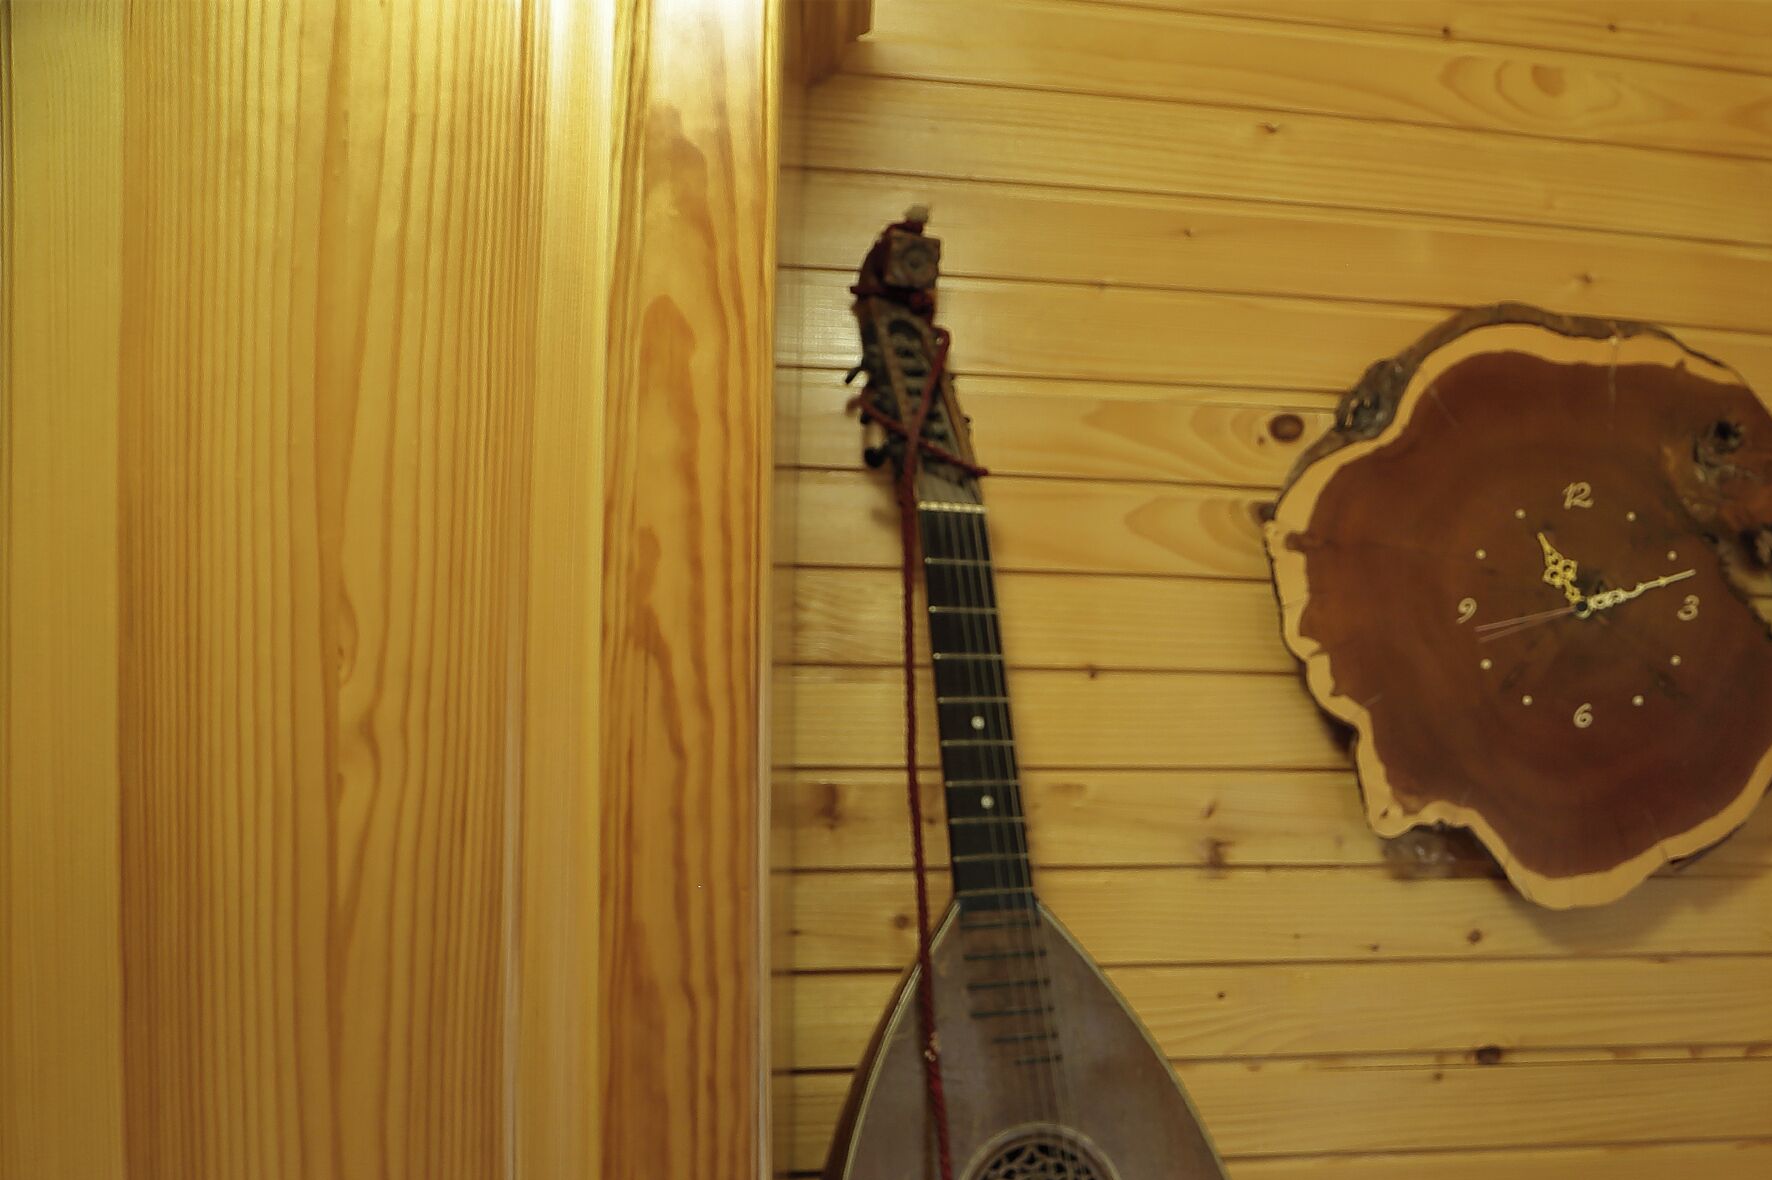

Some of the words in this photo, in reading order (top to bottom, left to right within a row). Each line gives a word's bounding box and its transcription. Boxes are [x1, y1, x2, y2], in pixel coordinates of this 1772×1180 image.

[1563, 481, 1594, 510] 12
[1456, 597, 1477, 624] 9
[1677, 595, 1699, 621] 3
[1573, 703, 1593, 728] 6
